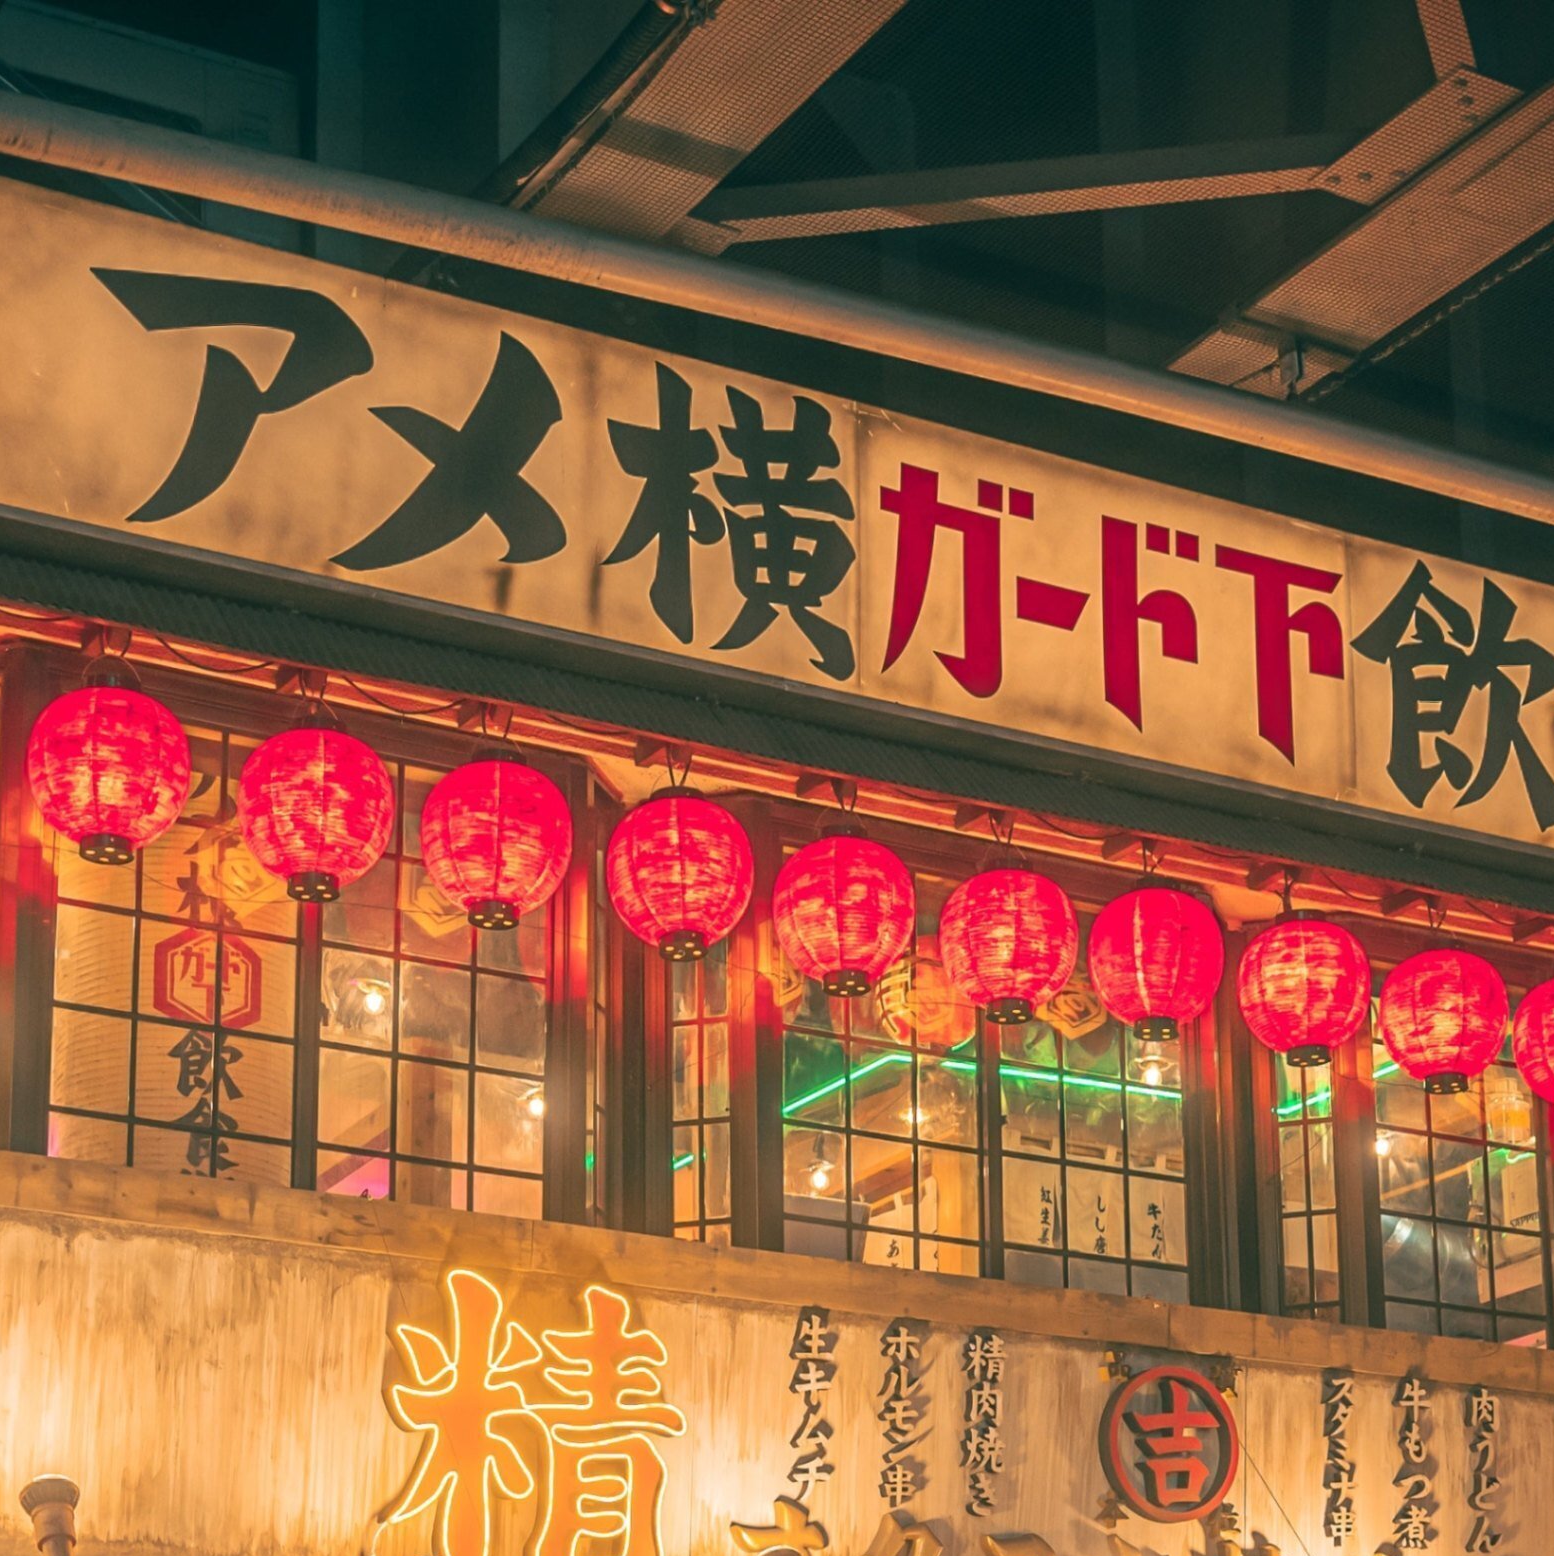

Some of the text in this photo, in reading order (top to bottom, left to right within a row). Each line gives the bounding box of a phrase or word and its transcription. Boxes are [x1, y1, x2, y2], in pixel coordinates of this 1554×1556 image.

[791, 1313, 835, 1500] 生キムチ
[880, 1324, 926, 1508] ホルモン串
[962, 1333, 1006, 1517] 精肉焼き
[1328, 1377, 1357, 1549] スタミナ串
[1468, 1388, 1501, 1554] 肉うどん
